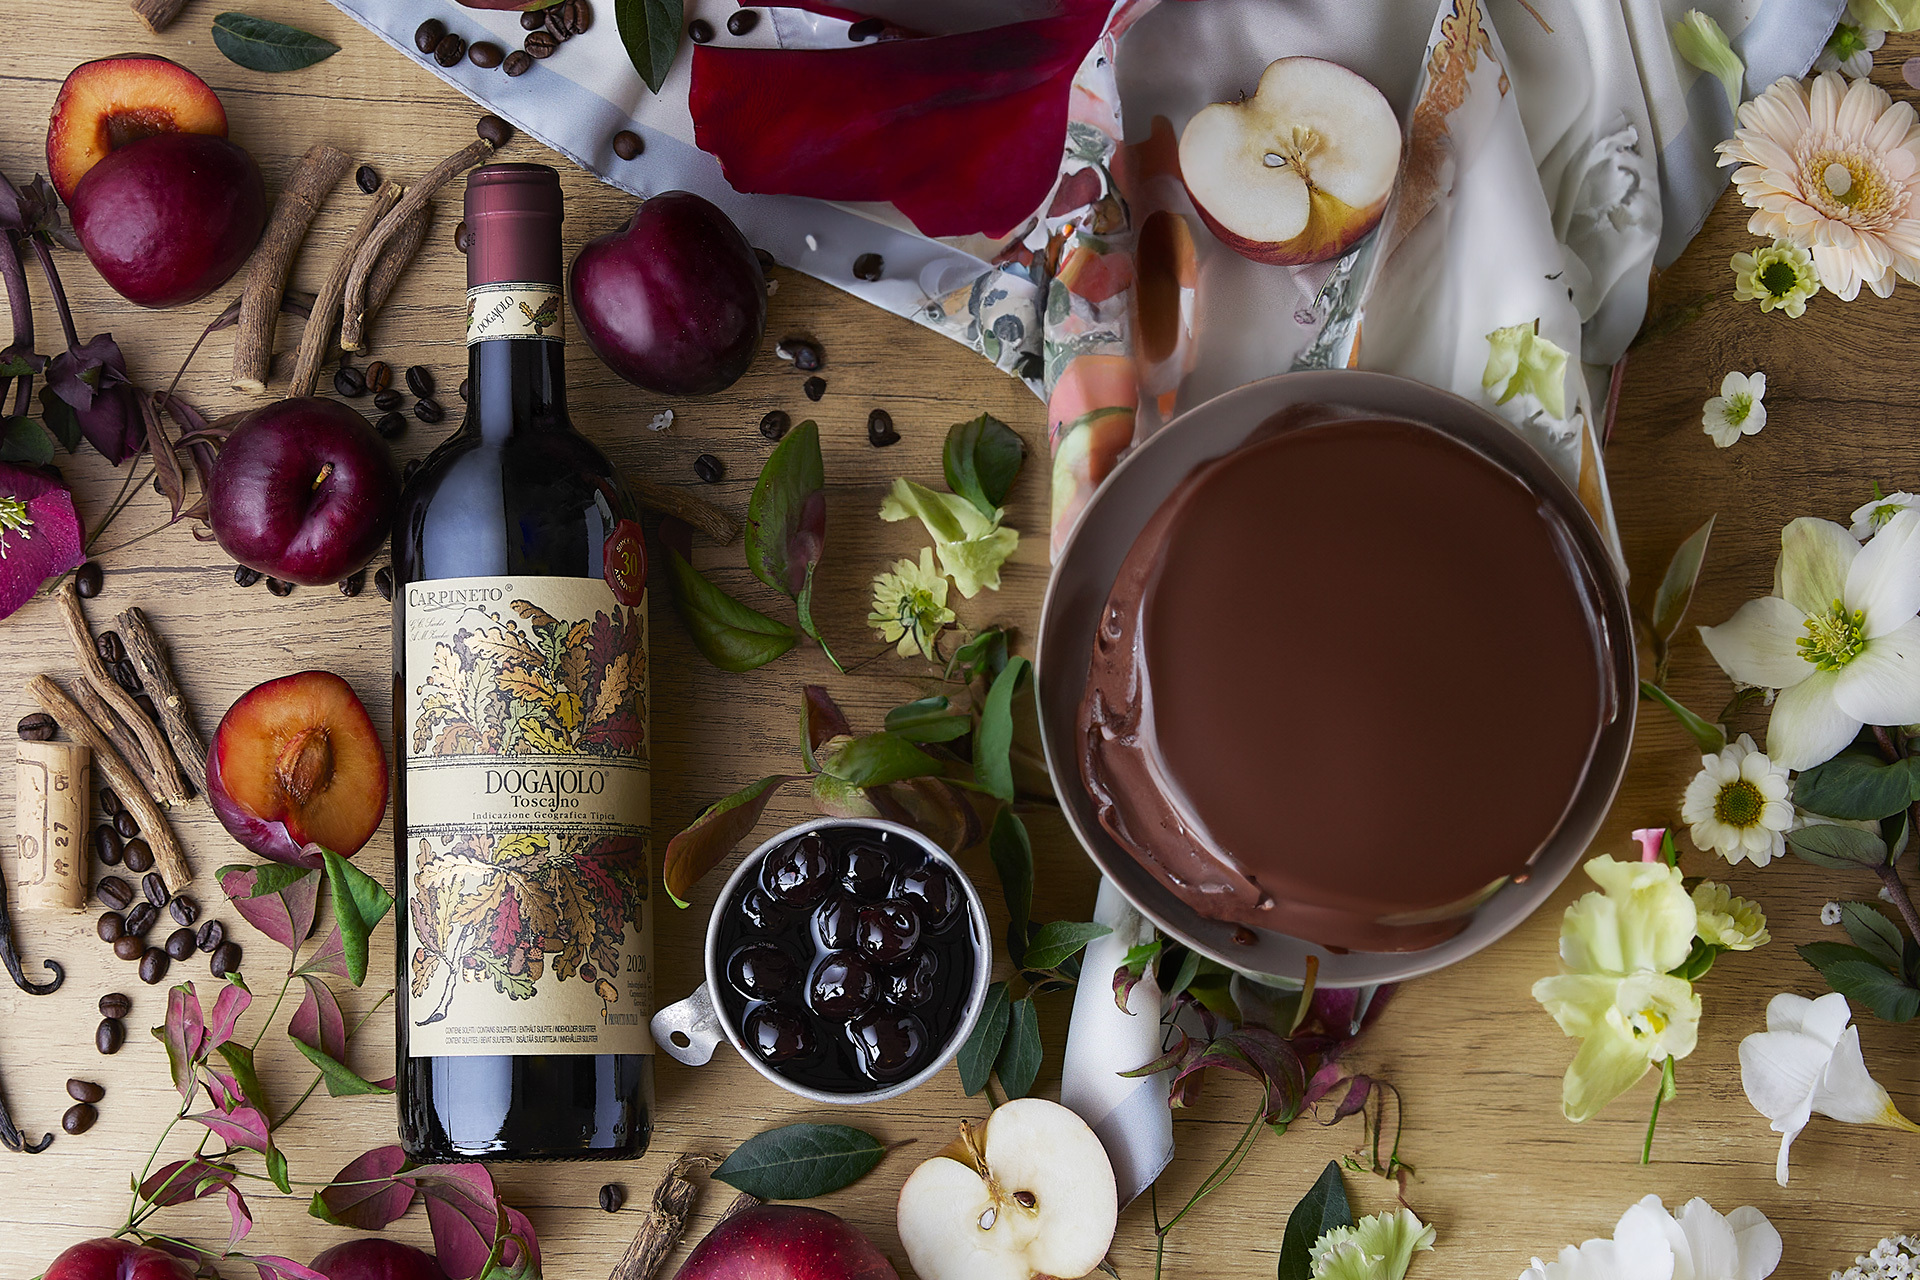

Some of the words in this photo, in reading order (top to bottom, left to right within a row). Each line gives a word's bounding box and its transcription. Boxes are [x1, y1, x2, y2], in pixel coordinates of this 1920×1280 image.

[476, 295, 515, 334] DOGAJOLO
[620, 551, 638, 577] 30
[408, 587, 503, 610] CARPINETO
[484, 769, 604, 810] DOGAJOLO
[510, 794, 579, 808] Toscano
[472, 811, 530, 820] Indicazione
[534, 811, 587, 821] Geografica
[590, 811, 615, 821] Tipica
[626, 954, 647, 973] 2020
